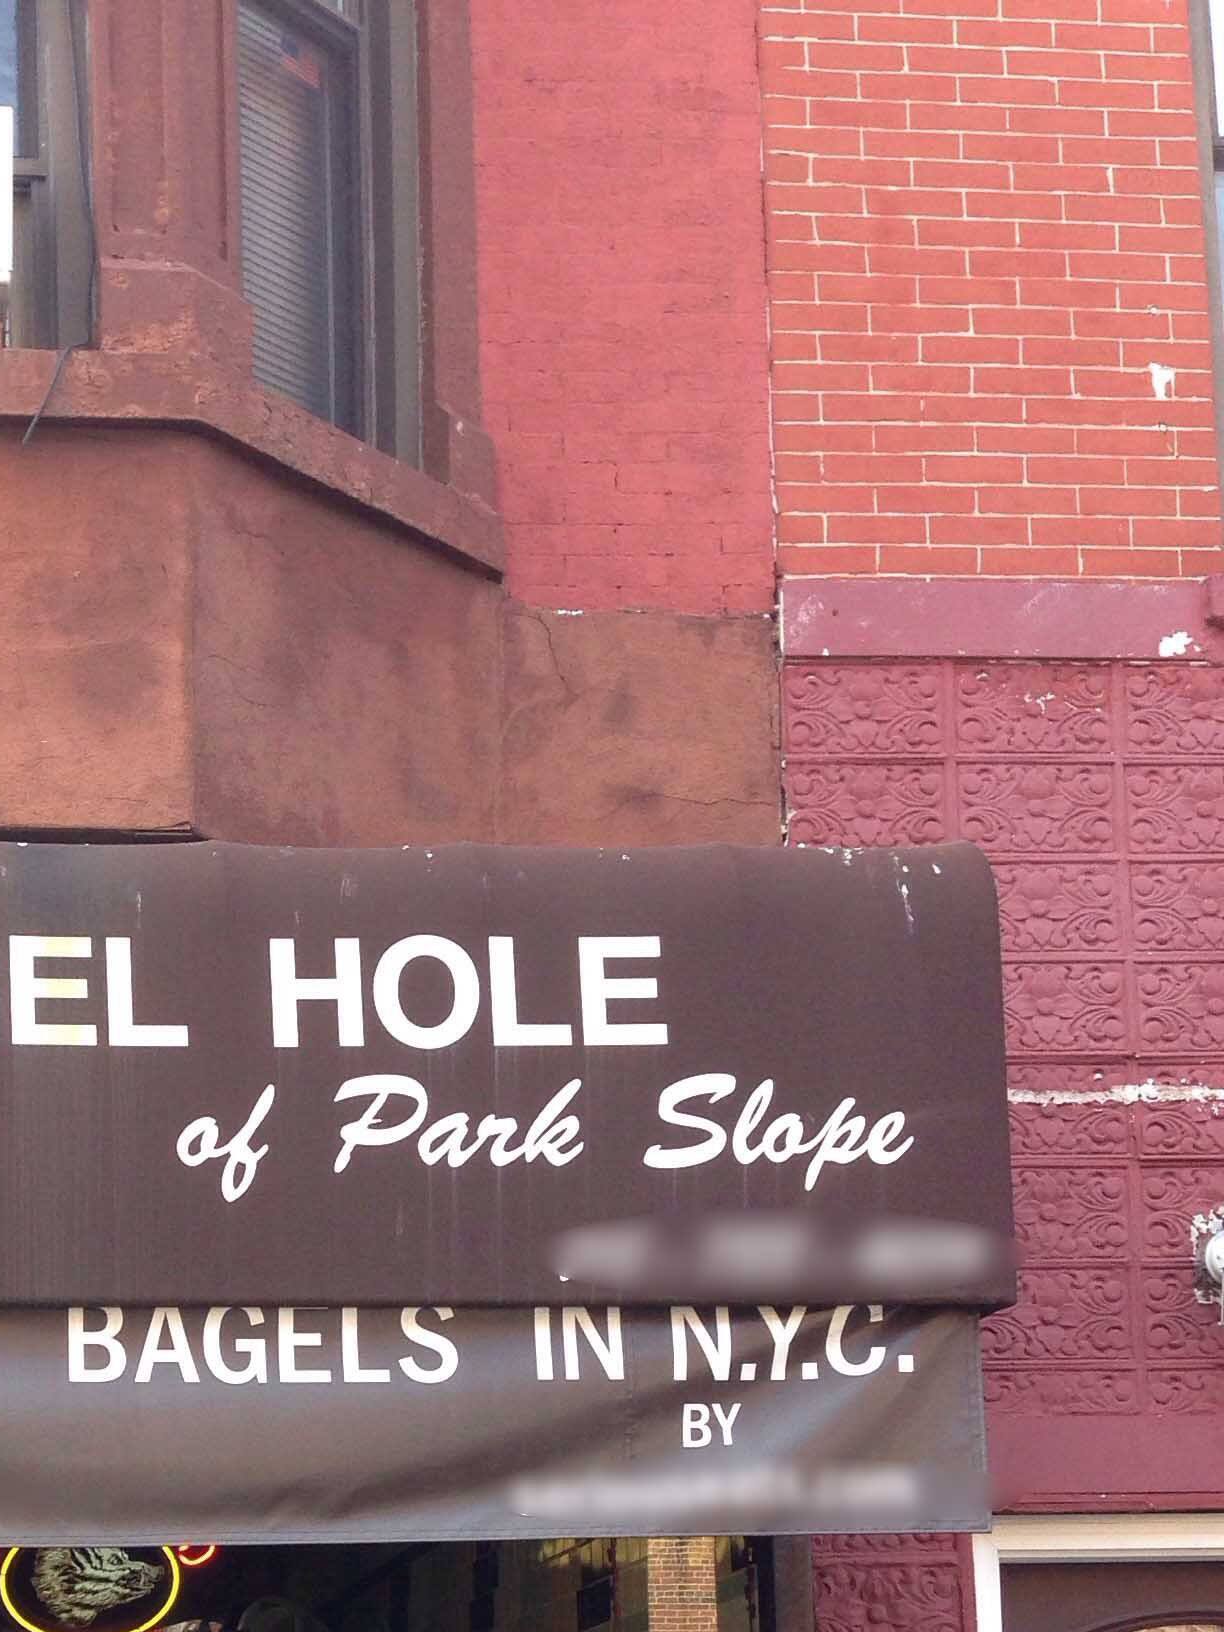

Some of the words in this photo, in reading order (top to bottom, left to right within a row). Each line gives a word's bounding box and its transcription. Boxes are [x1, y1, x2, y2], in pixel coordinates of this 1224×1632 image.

[269, 934, 669, 1050] HOLE
[176, 1084, 275, 1203] of
[333, 1074, 585, 1173] Park
[643, 1073, 914, 1192] Slope
[67, 1307, 460, 1385] BAGELS
[533, 1307, 626, 1381] IN
[671, 1306, 915, 1382] N.Y.C.
[682, 1402, 742, 1448] BY
